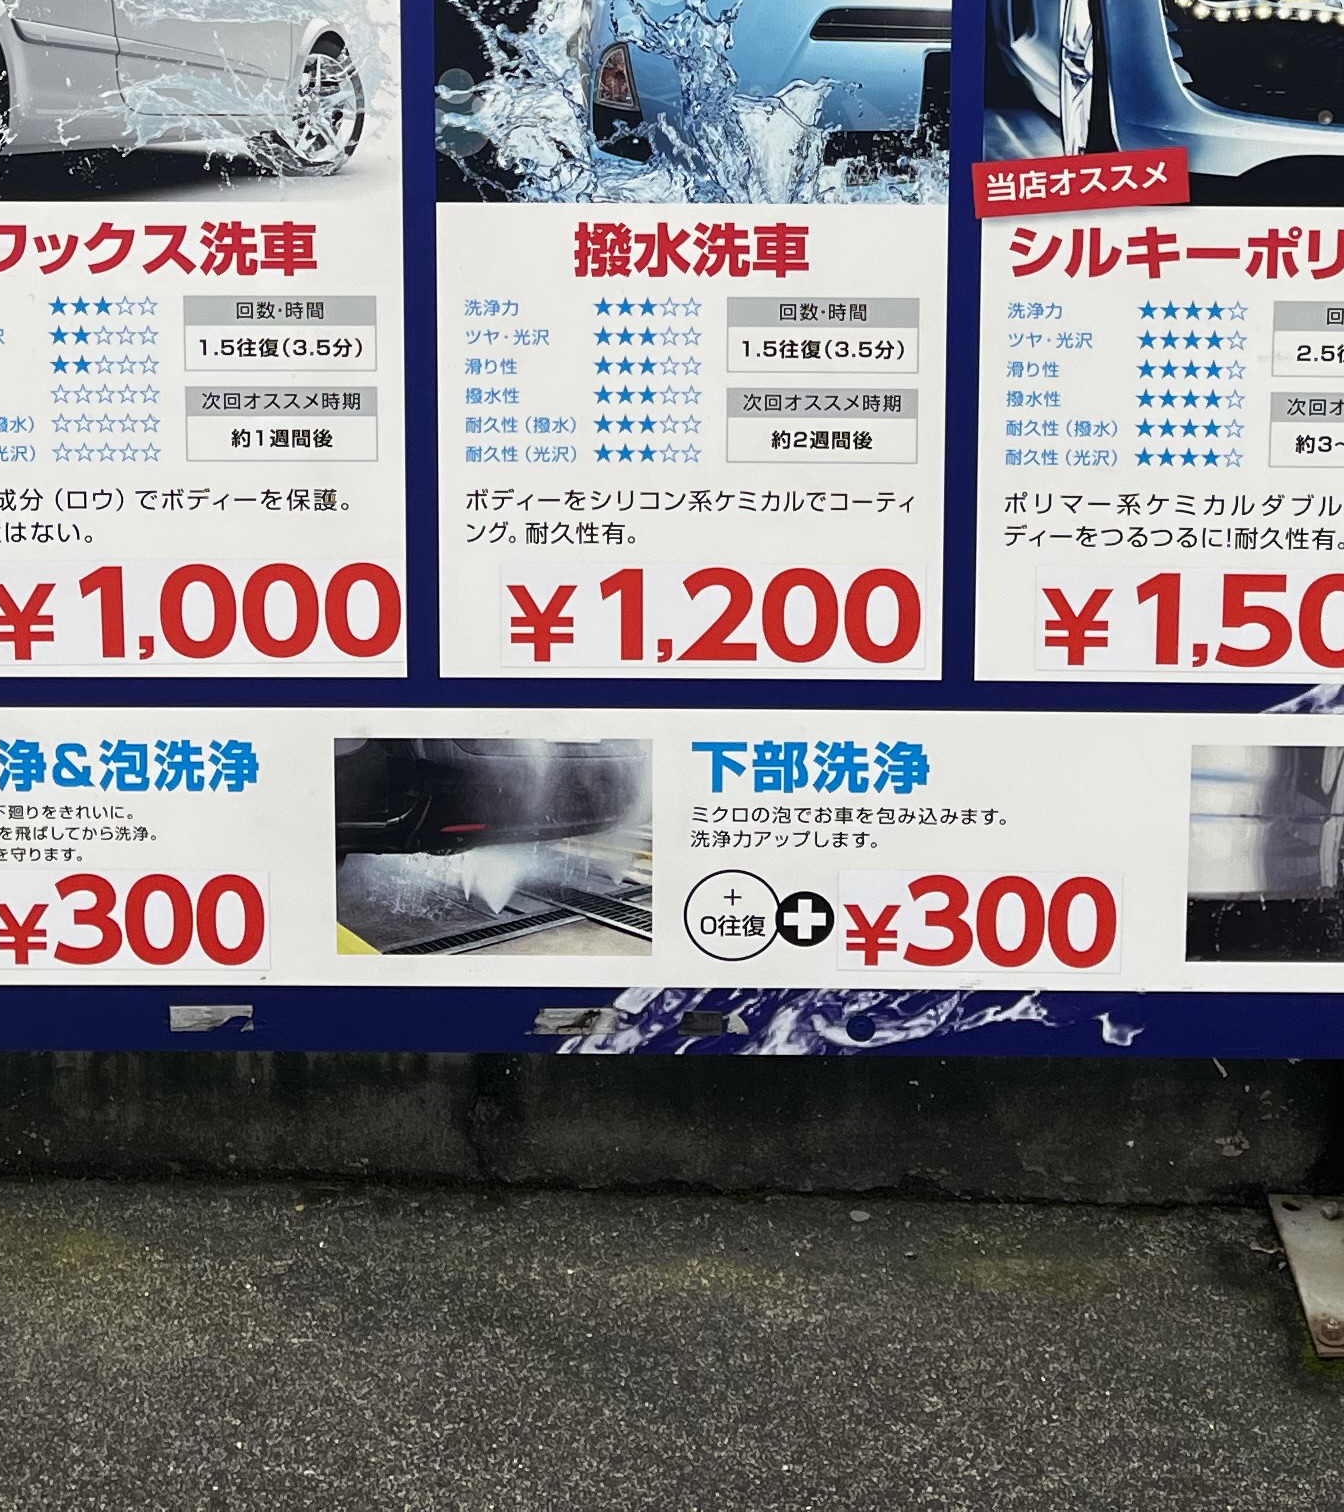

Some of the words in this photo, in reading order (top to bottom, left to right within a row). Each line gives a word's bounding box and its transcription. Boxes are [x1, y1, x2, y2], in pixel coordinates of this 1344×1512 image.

[986, 161, 1168, 203] 当店オススメ
[574, 222, 809, 278] 撥水洗車
[236, 302, 324, 319] 回数・時間
[465, 299, 518, 316] 洗浄力
[780, 303, 866, 321] 回数・時間
[1008, 302, 1062, 319] 洗浄力
[200, 338, 362, 357] 1.5往復(3.5分)
[742, 340, 904, 360] 1.5往復(3.5分)
[465, 358, 517, 375] 滑り性
[1007, 361, 1059, 378] 滑り性
[202, 392, 360, 410] 次回オススメ時期
[466, 388, 519, 404] 撥水性
[743, 394, 901, 412] 次回オススメ時期
[1007, 391, 1061, 407] 撥水性
[232, 429, 333, 448] 約1週間後
[772, 430, 872, 450] 約2週間後
[467, 489, 914, 513] ボディーをシリコン系ケミカルでコーティ
[467, 521, 635, 545] ング。耐久性有。
[507, 567, 921, 663] ¥1,200
[692, 741, 930, 794] 下部洗浄
[692, 806, 1006, 825] ミクロの泡でお車を包み込みます。
[691, 830, 877, 848] 洗浄力アップします。
[844, 875, 1116, 968] ¥300
